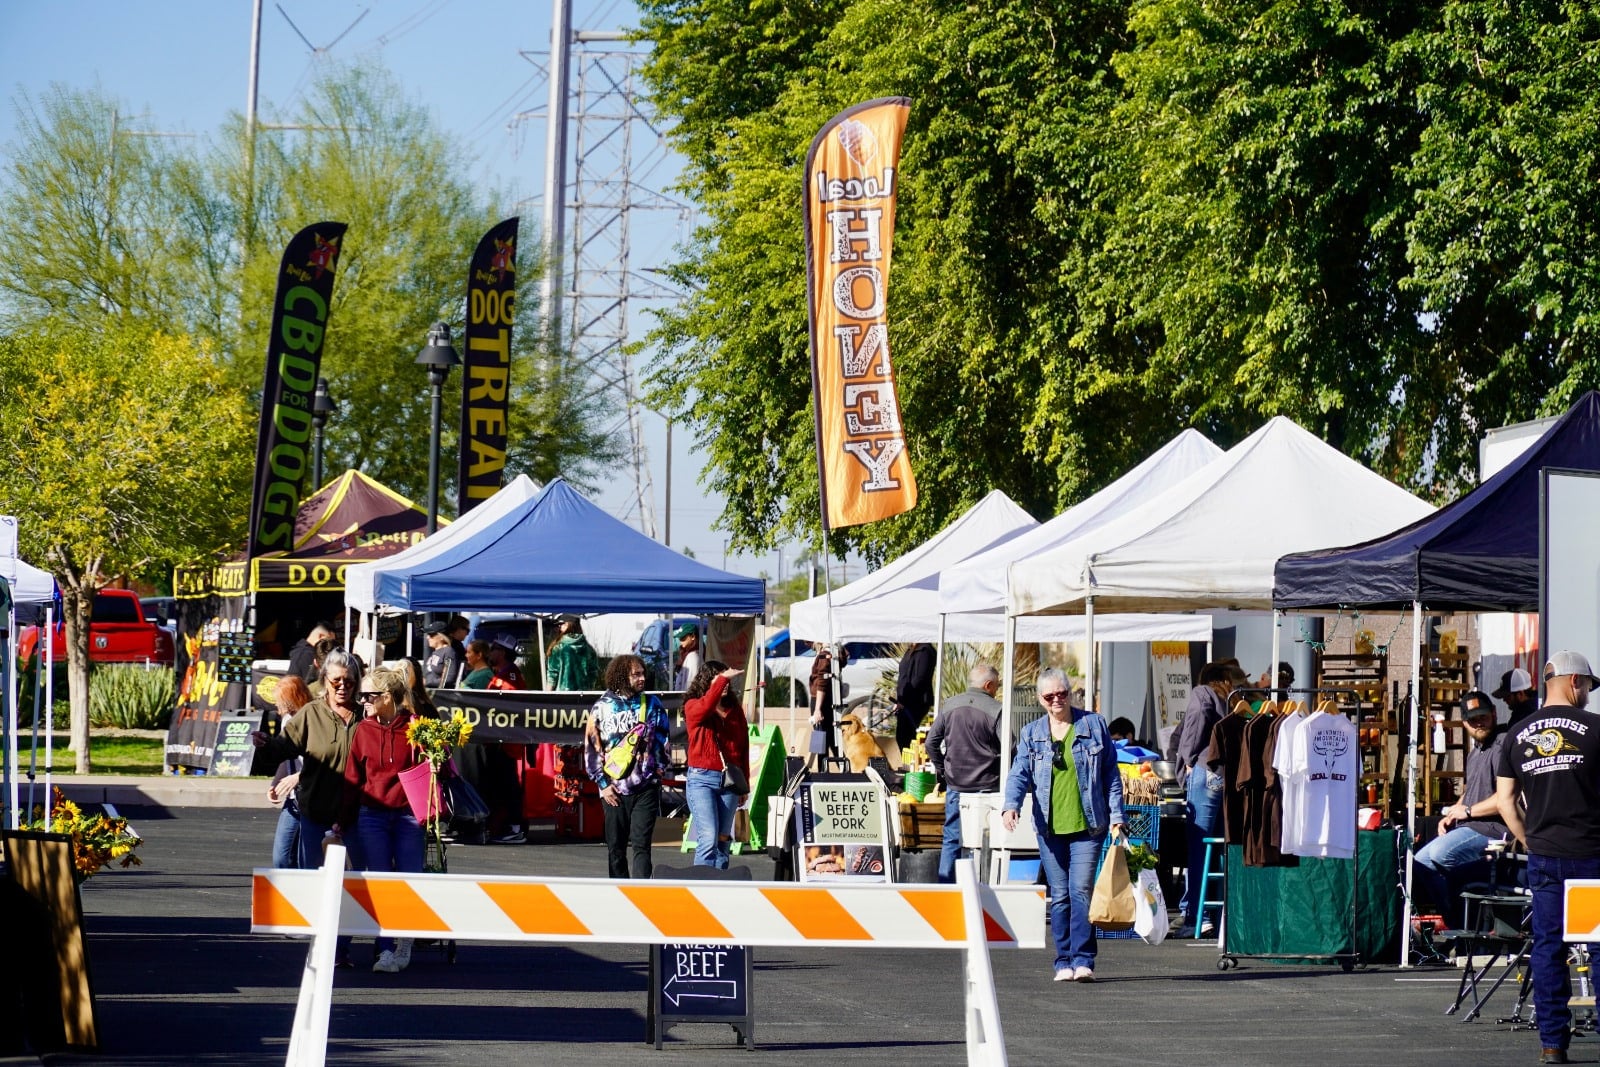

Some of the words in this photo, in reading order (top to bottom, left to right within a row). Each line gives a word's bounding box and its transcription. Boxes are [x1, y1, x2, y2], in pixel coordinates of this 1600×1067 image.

[471, 288, 516, 326] DOG
[278, 285, 327, 393] CBD
[281, 391, 308, 409] FOR
[258, 403, 313, 549] DOGS
[487, 707, 519, 728] for
[524, 708, 591, 728] HUMA
[225, 722, 251, 734] CBD
[1515, 717, 1589, 745] FASTHOUSE
[1521, 756, 1556, 773] SERVICE
[1556, 754, 1584, 764] DEPT.
[818, 790, 838, 803] WE
[842, 790, 876, 803] HAVE
[826, 804, 856, 816] BEEF
[861, 803, 869, 817] &
[832, 817, 866, 830] PORK
[676, 951, 728, 978] BEEF
